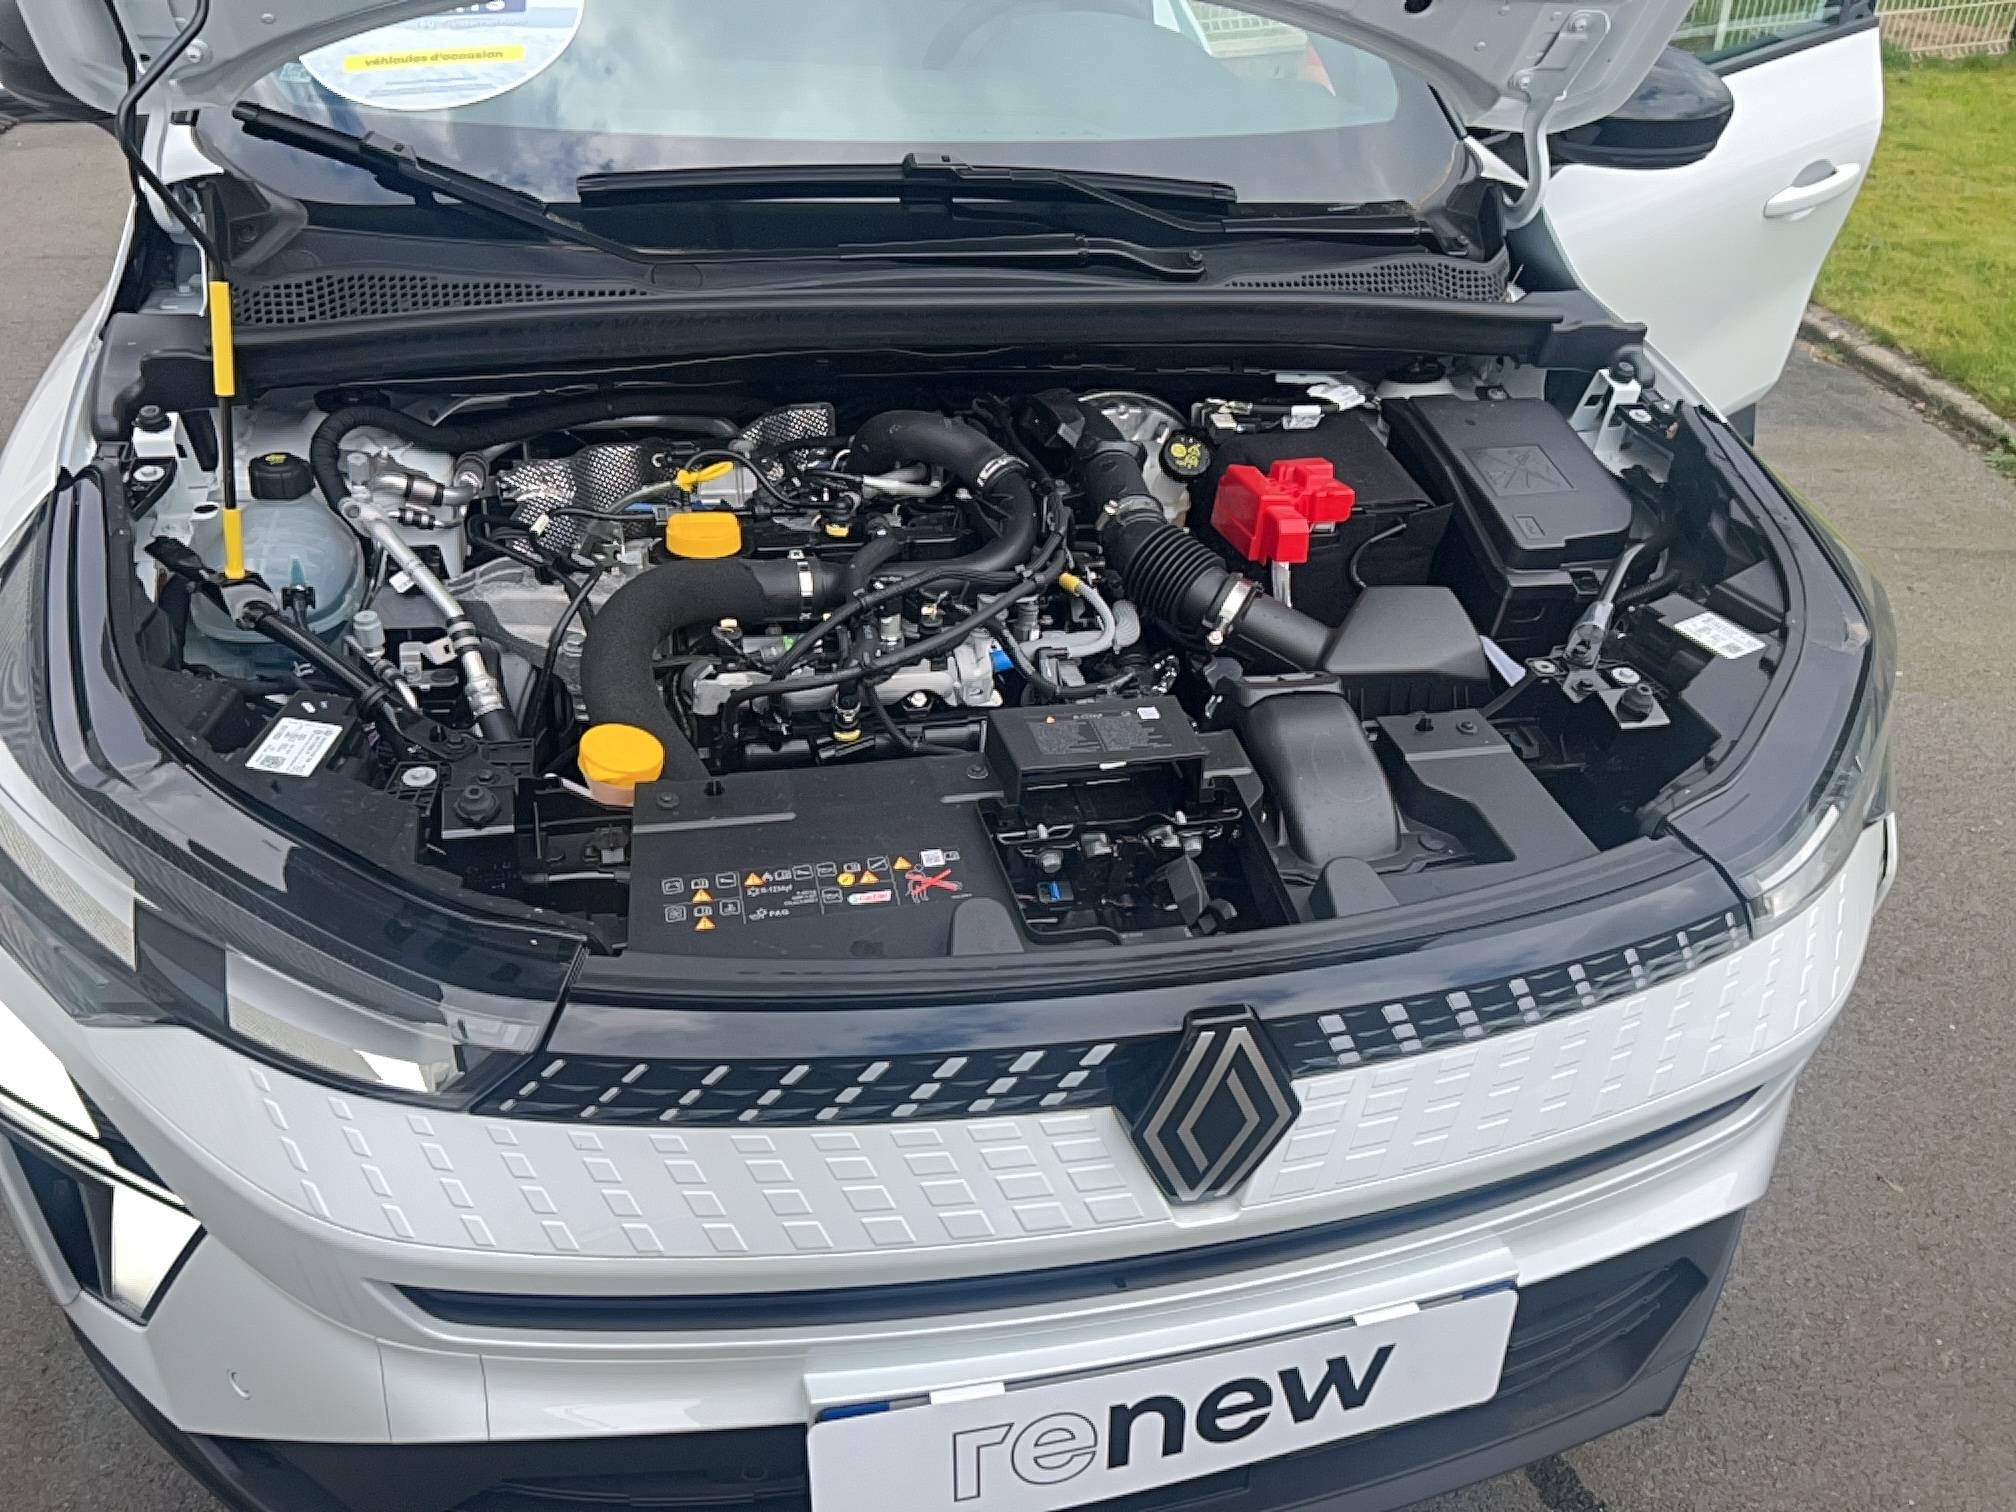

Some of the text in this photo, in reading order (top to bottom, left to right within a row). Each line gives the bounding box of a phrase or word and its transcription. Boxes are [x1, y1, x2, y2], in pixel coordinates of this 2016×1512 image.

[365, 50, 504, 67] véhicules d'occasion
[952, 1343, 1397, 1502] renew
